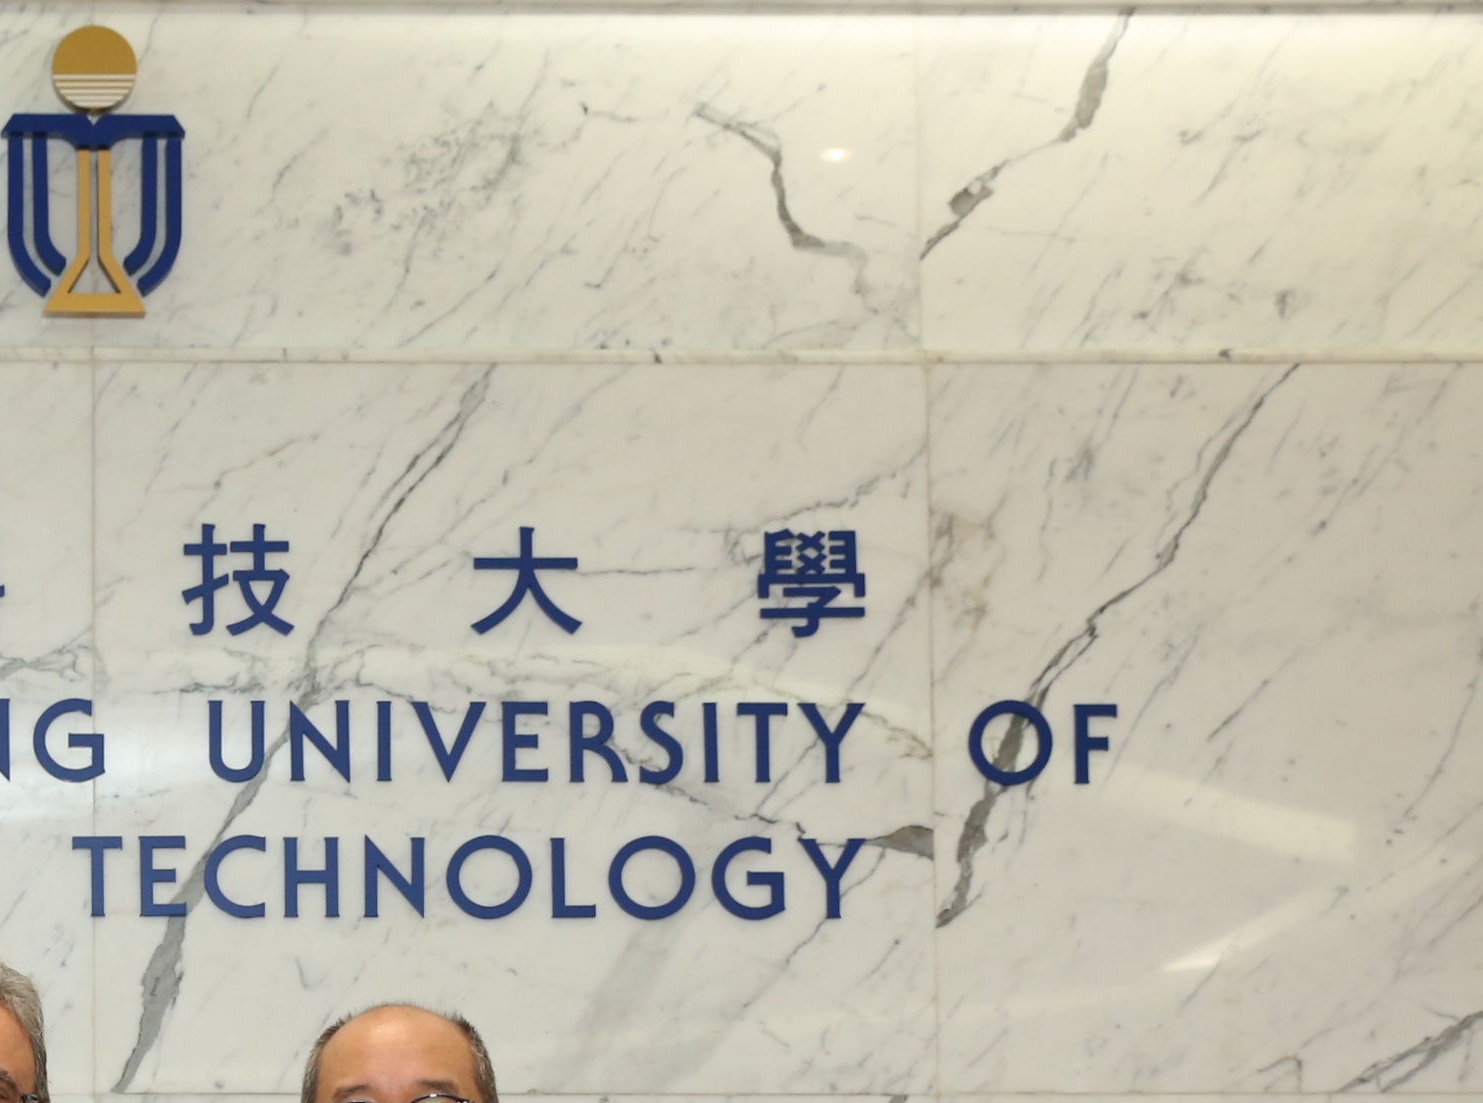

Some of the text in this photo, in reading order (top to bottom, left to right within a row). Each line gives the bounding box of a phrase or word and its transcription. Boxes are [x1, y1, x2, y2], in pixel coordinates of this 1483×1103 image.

[208, 699, 865, 784] UNIVERSITY
[969, 699, 1118, 786] OF
[72, 835, 866, 921] TECHNOLOGY
